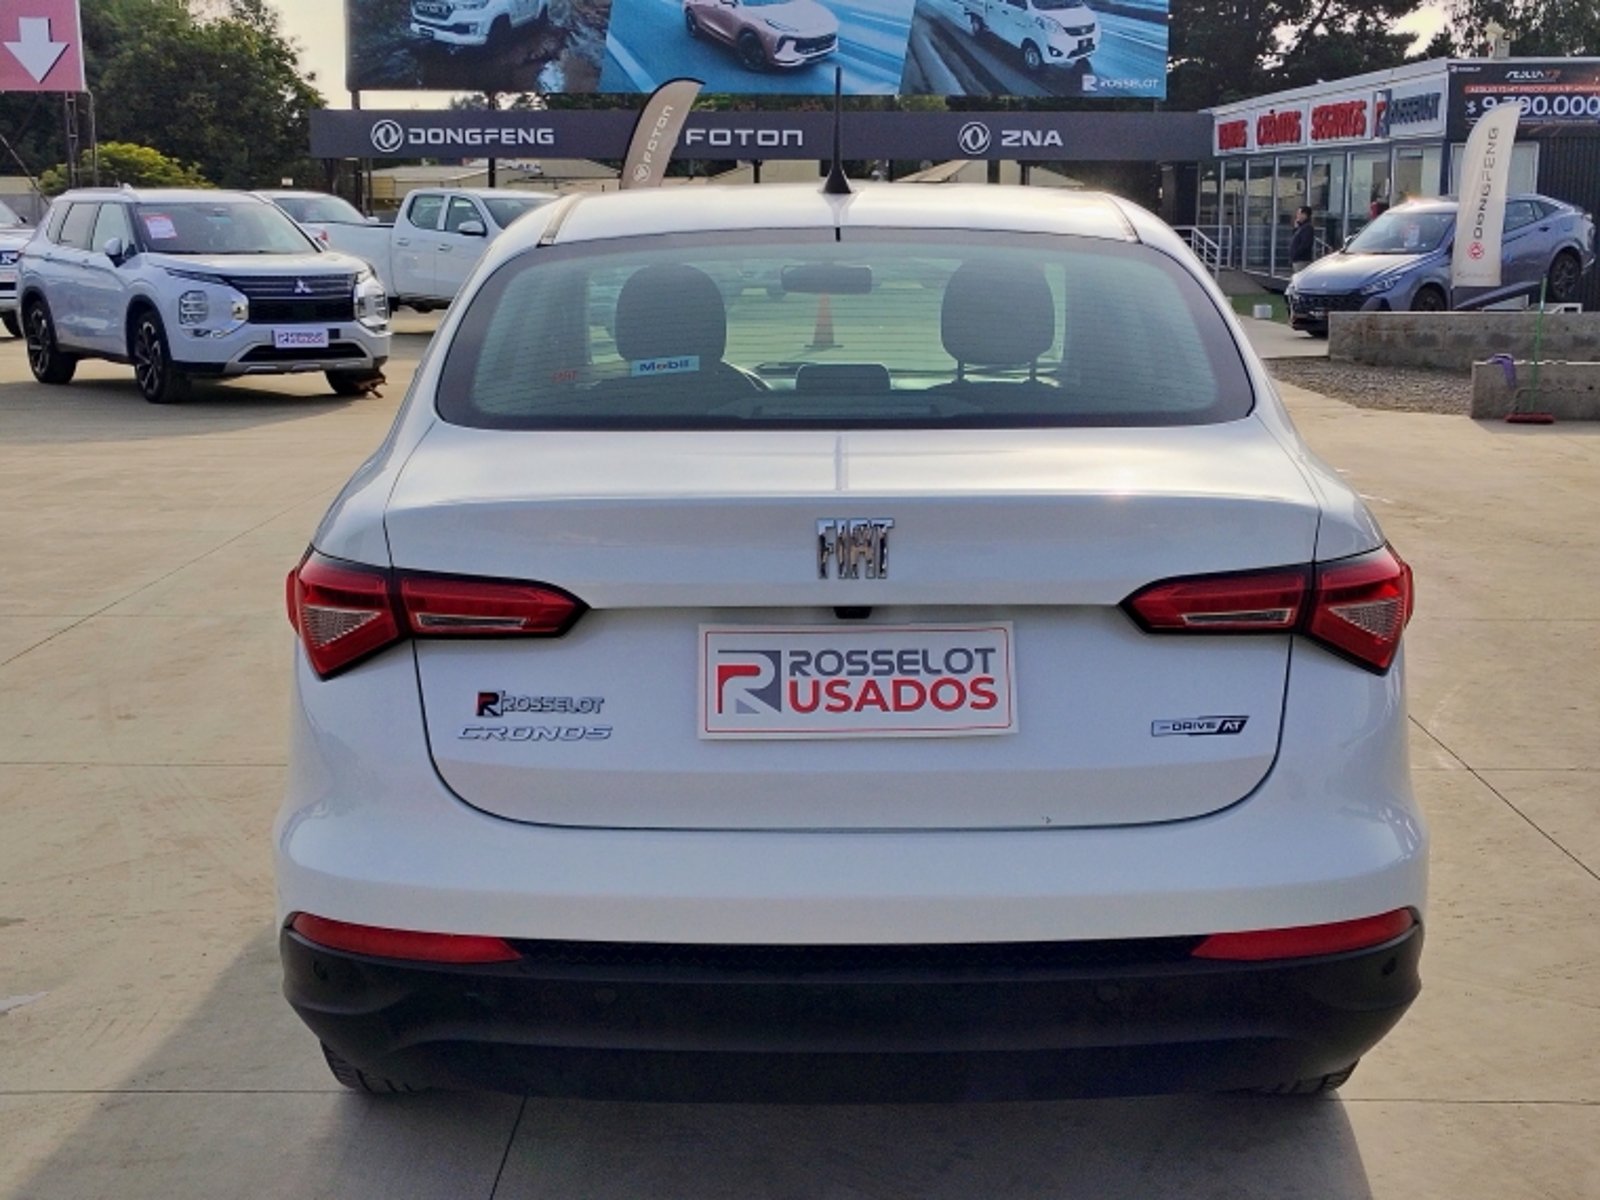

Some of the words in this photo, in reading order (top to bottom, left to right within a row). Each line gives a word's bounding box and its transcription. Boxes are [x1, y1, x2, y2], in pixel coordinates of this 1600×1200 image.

[408, 127, 555, 145] DONGFENG
[643, 104, 675, 163] FOTON
[685, 128, 804, 146] FOTON
[1001, 129, 1063, 147] ZNA
[1473, 127, 1499, 240] DONGFENG
[639, 359, 690, 373] Mobil
[816, 518, 894, 579] FIAT
[788, 647, 996, 677] ROSSELOT
[788, 676, 999, 714] USADOS
[502, 695, 605, 714] ROSSELOT
[457, 724, 613, 741] CRONOS
[1222, 721, 1242, 731] AT
